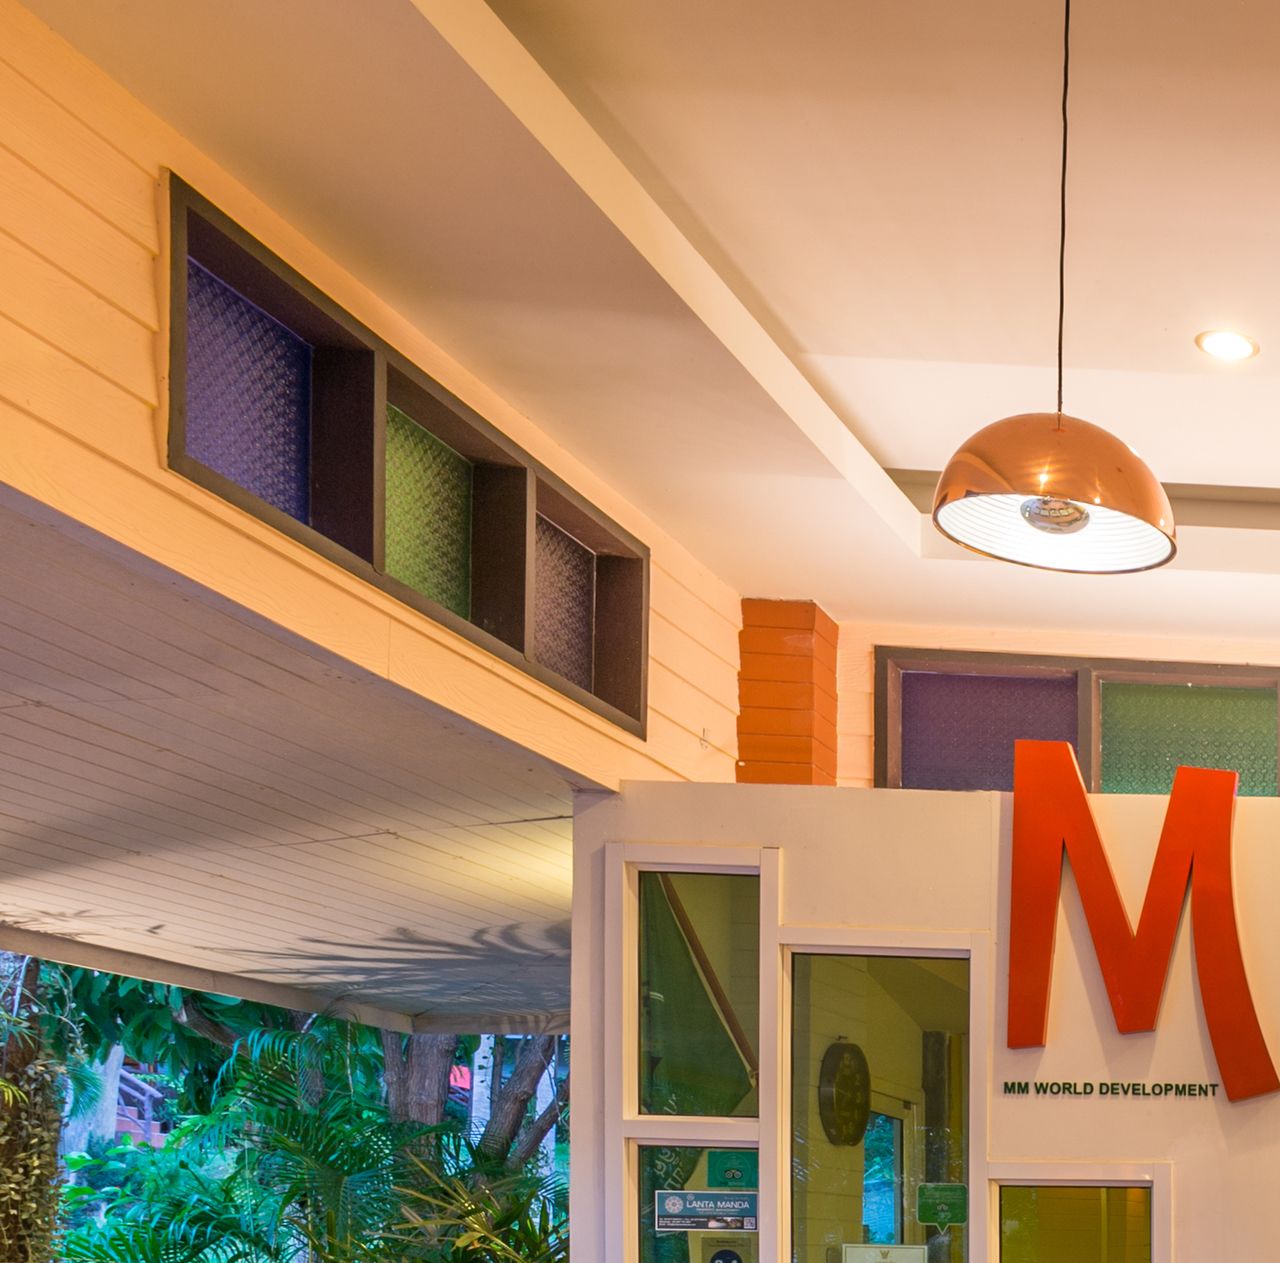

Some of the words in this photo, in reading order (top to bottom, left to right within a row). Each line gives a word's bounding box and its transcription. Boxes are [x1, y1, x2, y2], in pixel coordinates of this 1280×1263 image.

[1003, 1082, 1029, 1095] MM
[1034, 1082, 1095, 1096] WORLD
[1099, 1082, 1219, 1097] DEVELOPMENT
[686, 1200, 715, 1209] LANTA
[717, 1200, 750, 1209] MANDA
